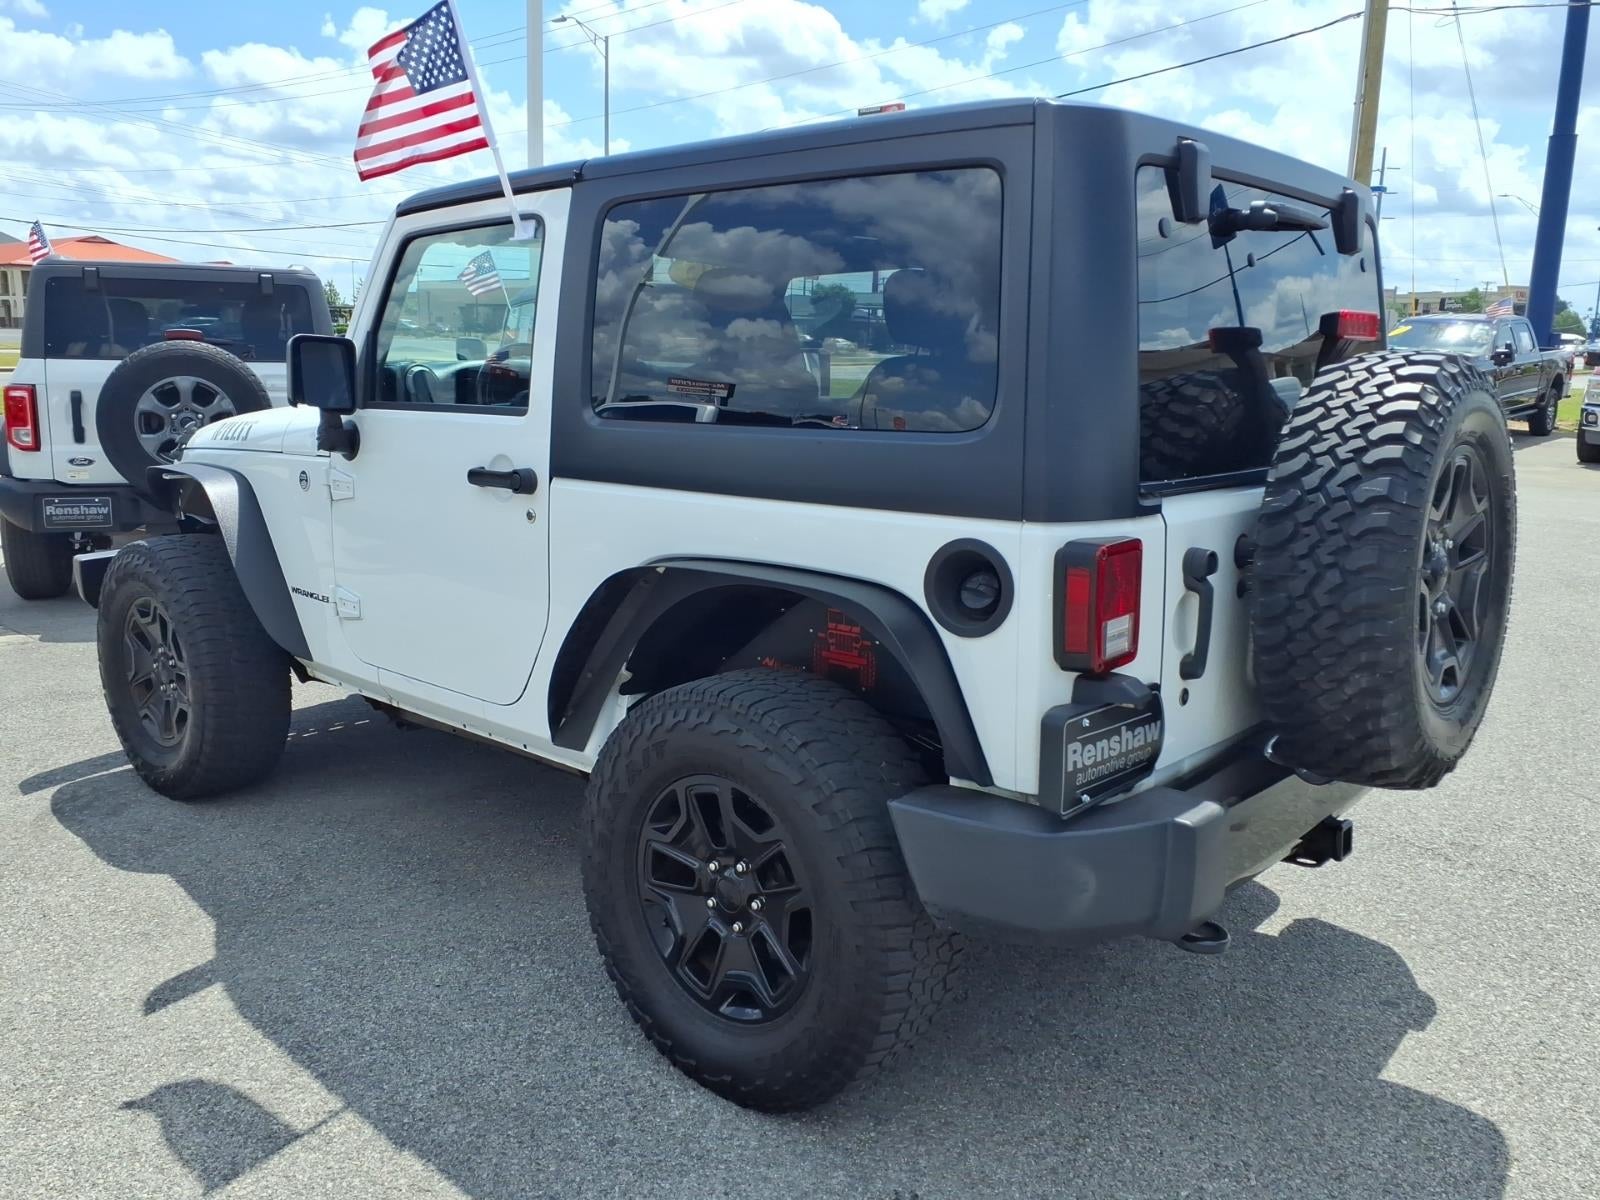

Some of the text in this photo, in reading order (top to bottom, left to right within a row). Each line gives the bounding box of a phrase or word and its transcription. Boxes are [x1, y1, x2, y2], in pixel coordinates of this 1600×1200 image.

[45, 505, 109, 515] Renshaw
[1066, 720, 1161, 772] Renshaw
[1075, 745, 1152, 786] automotive group
